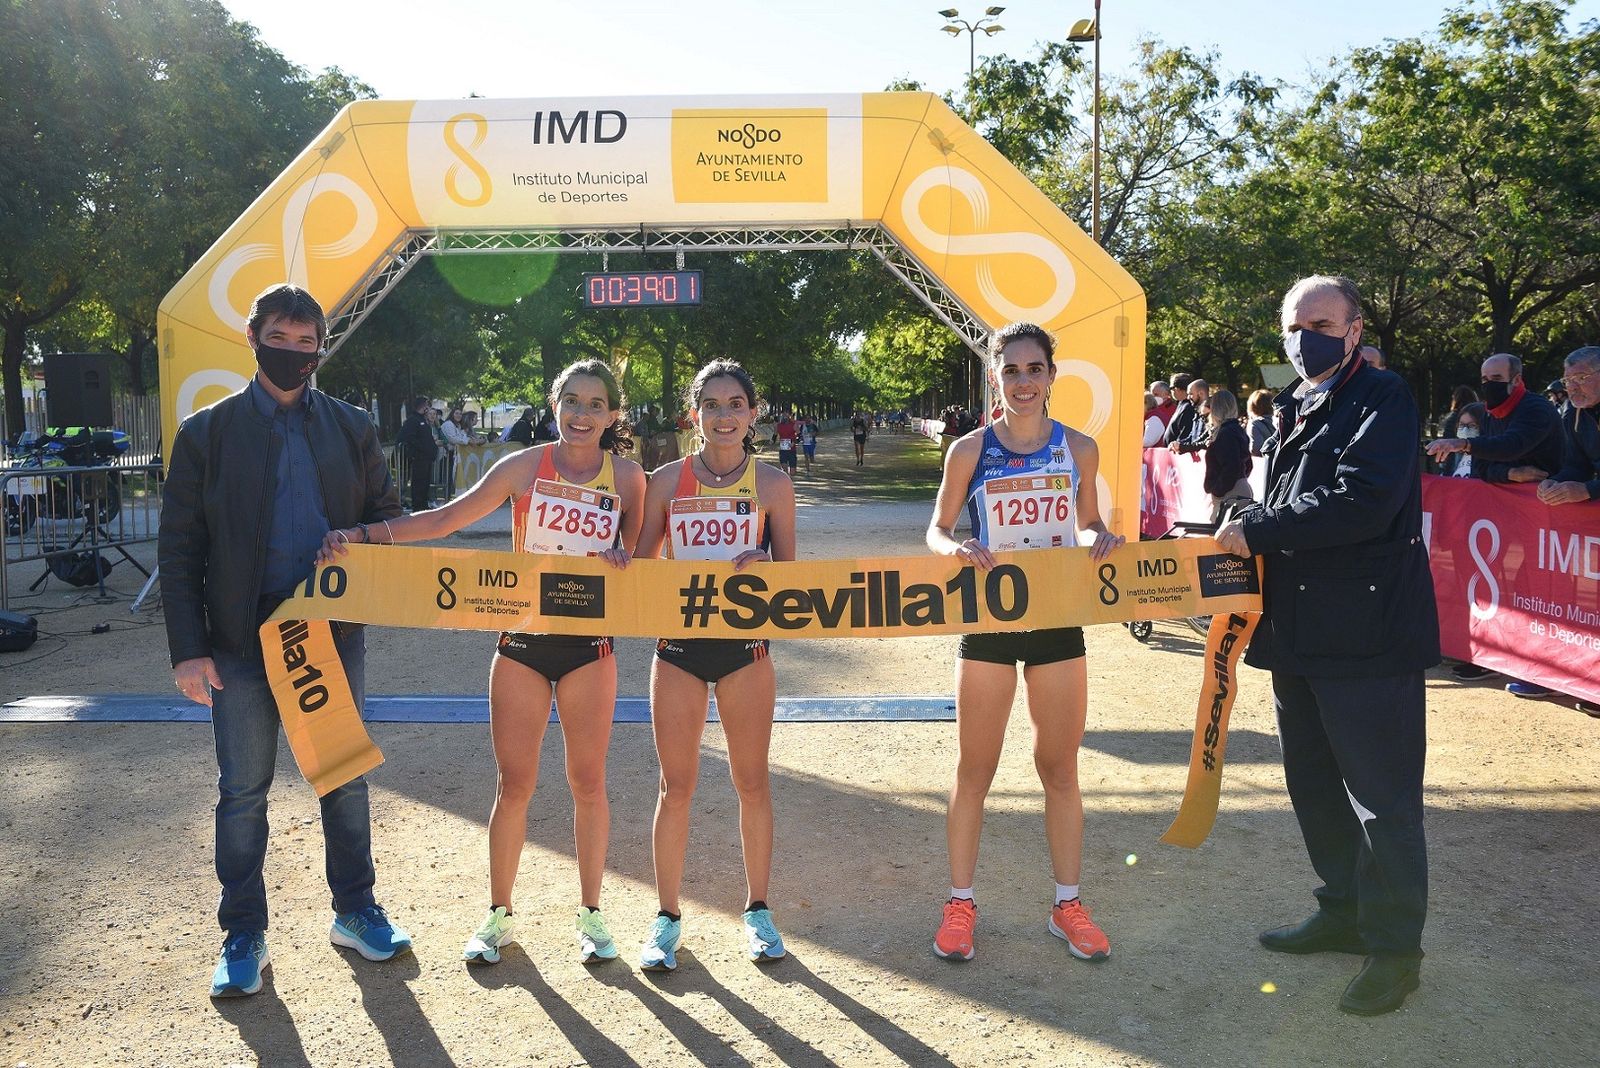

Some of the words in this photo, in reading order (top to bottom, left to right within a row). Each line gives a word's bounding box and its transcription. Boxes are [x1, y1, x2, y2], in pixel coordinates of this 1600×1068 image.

[532, 110, 627, 144] IMD
[696, 152, 803, 165] AYUNTAMIENTO
[512, 173, 572, 186] Instituto
[577, 171, 648, 187] Municipal
[713, 170, 730, 182] DE
[735, 168, 787, 182] SEVILLA
[538, 192, 556, 203] de
[560, 191, 629, 204] Deportes
[992, 495, 1069, 527] 12976
[536, 501, 613, 540] 12853
[676, 518, 751, 547] 12991
[1137, 558, 1178, 577] IMD
[478, 568, 518, 589] IMD
[679, 564, 1029, 630] #Sevilla10
[1126, 587, 1157, 597] Instituto
[1158, 584, 1192, 594] Municipal
[1149, 594, 1182, 604] Deportes
[464, 596, 495, 606] Instituto
[496, 598, 531, 609] Municipal
[486, 605, 520, 615] Deportes
[1513, 591, 1563, 618] Instituto
[1530, 619, 1546, 637] de
